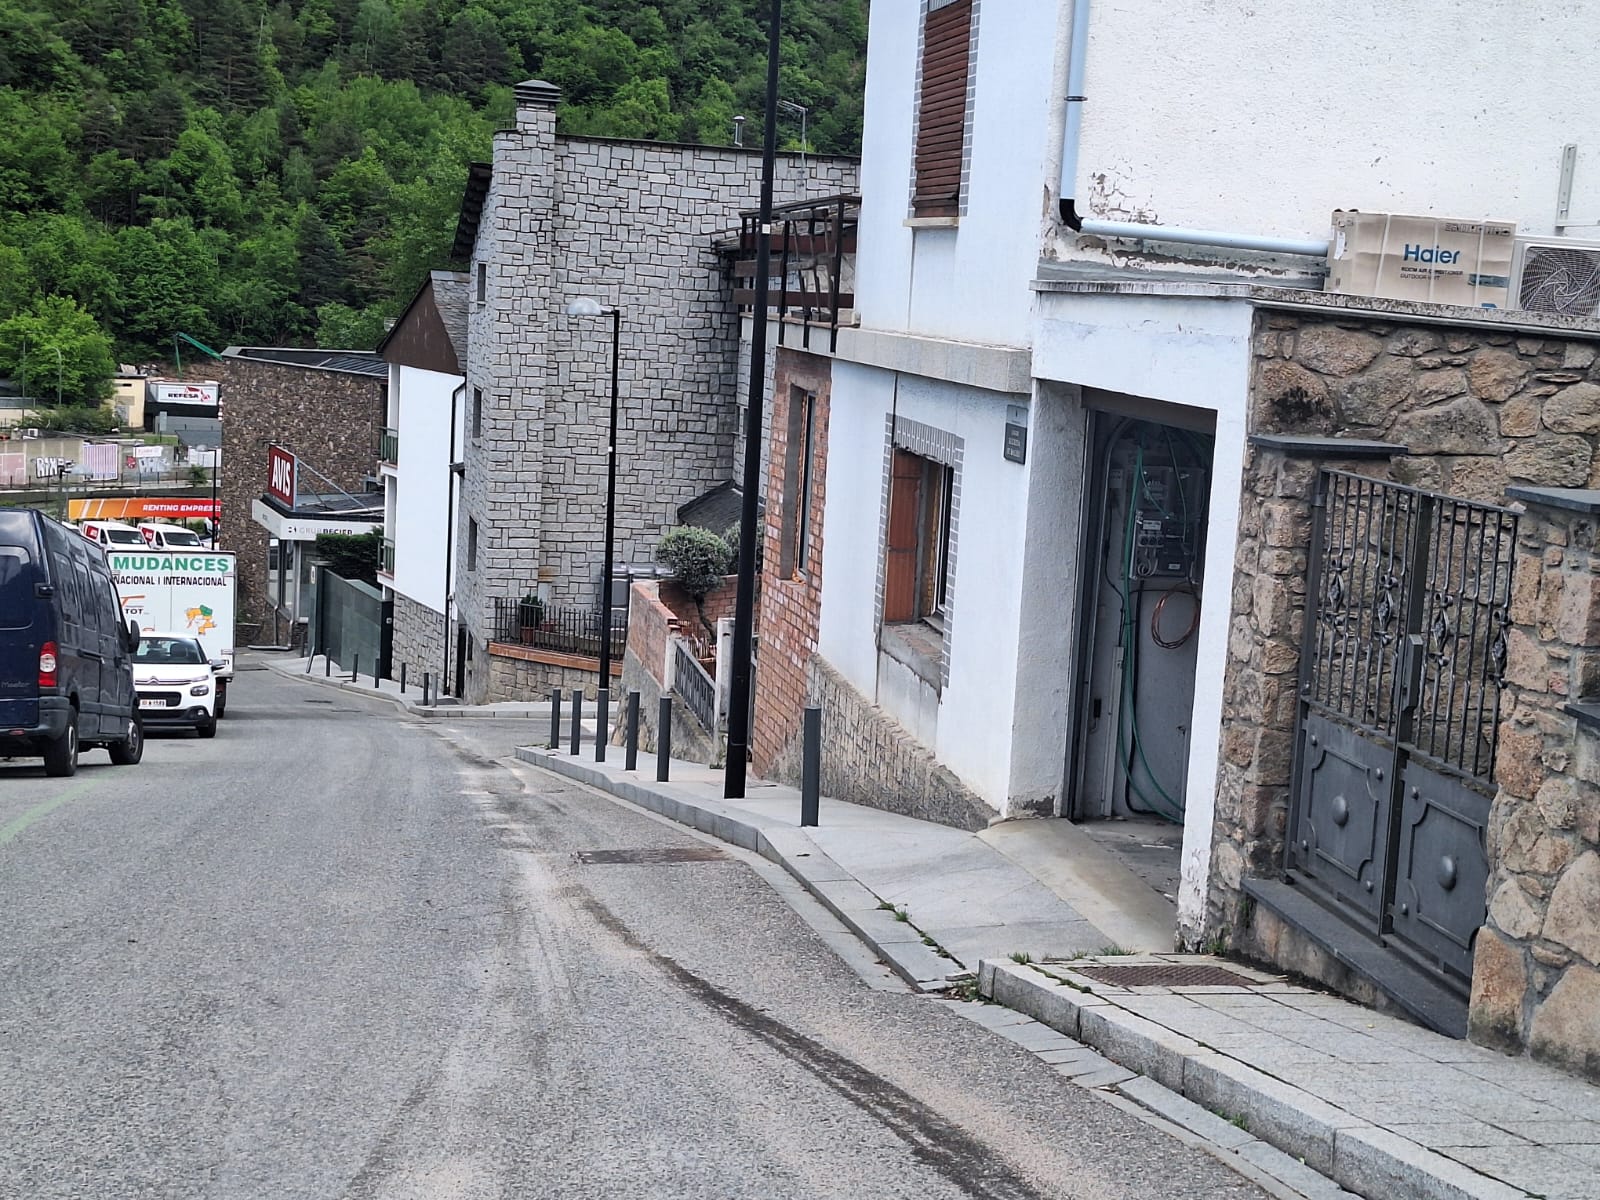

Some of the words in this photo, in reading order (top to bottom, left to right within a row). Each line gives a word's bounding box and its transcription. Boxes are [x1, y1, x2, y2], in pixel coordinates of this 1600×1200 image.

[1403, 244, 1460, 264] Haier
[271, 455, 291, 497] AVIS
[143, 504, 179, 512] RENTING
[113, 556, 229, 572] MUDANCES
[113, 575, 155, 585] NACIONAL
[163, 576, 227, 586] INTERNACIONAL
